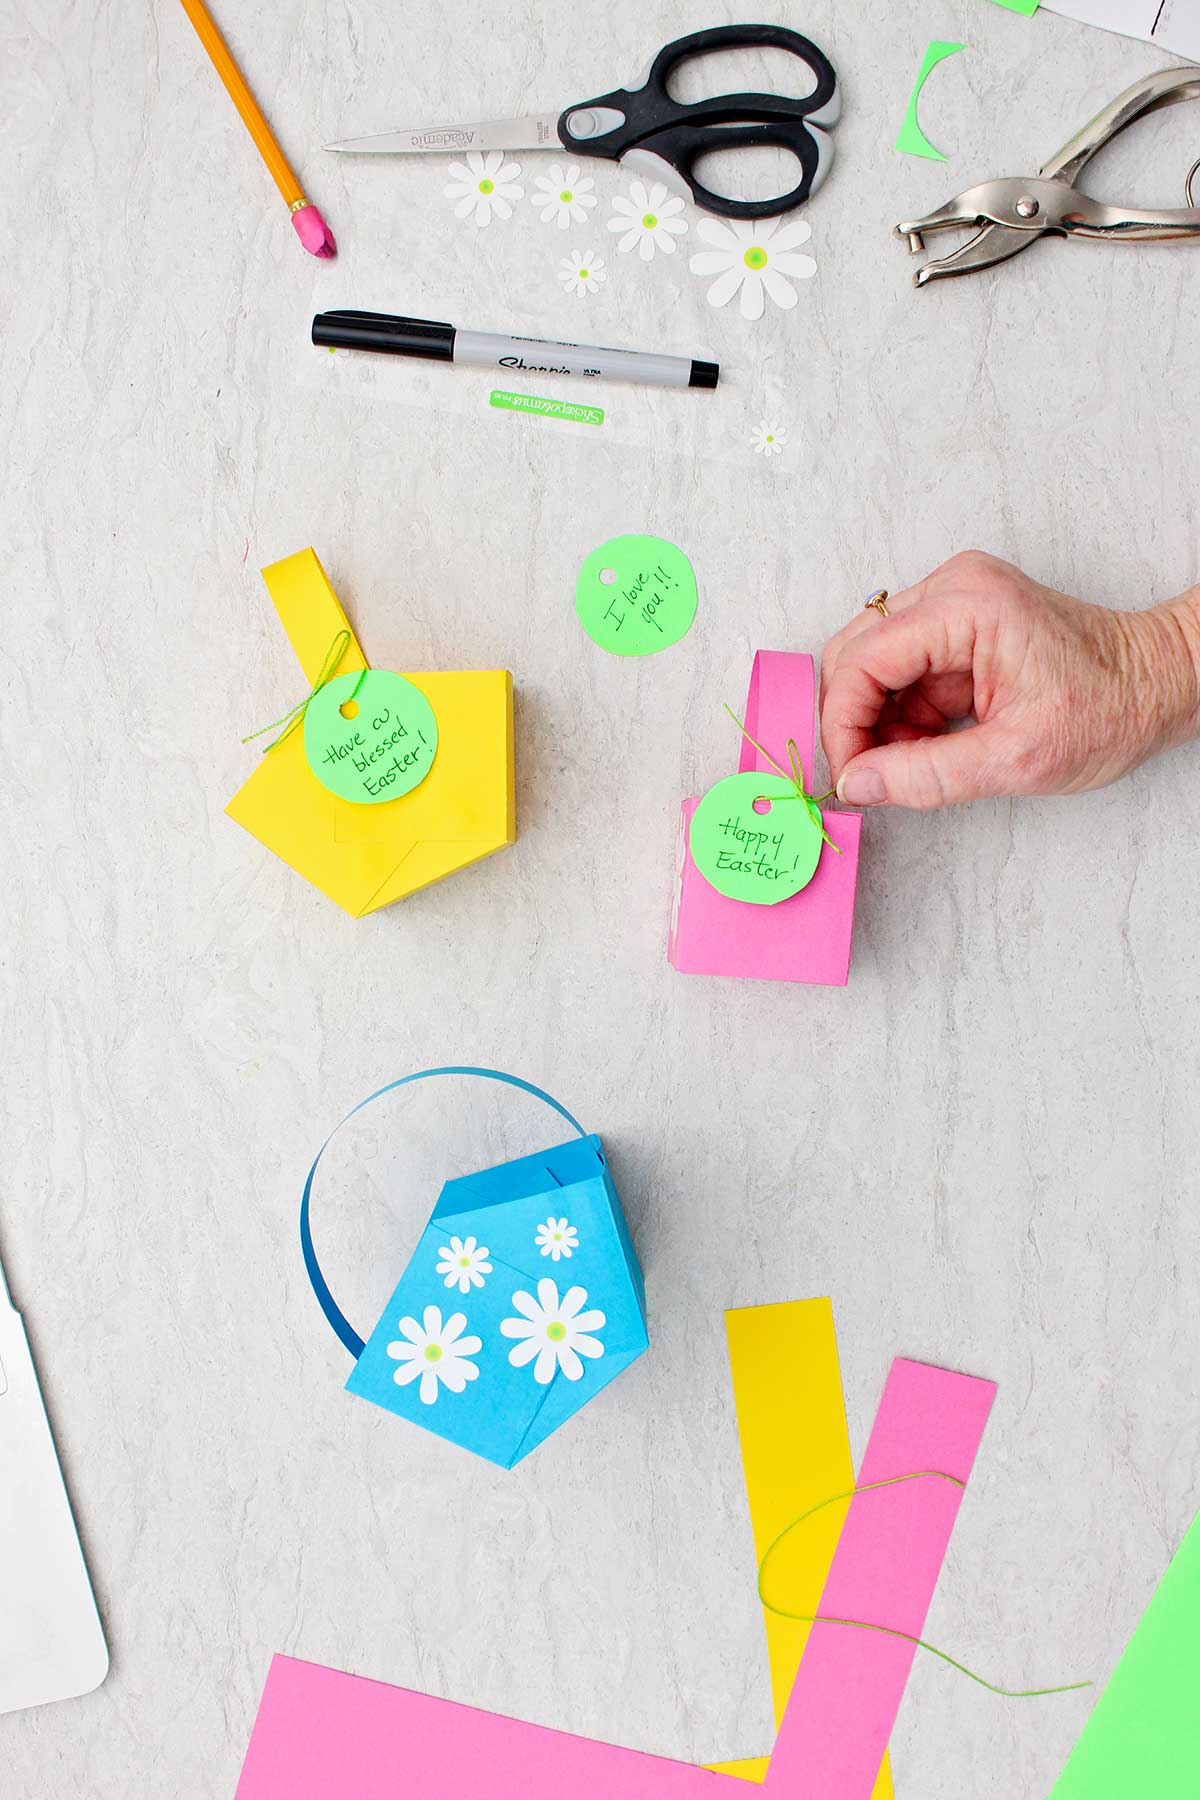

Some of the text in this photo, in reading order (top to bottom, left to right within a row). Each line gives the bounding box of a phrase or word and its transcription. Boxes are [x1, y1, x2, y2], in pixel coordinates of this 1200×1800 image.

[410, 131, 476, 148] Academic
[603, 573, 650, 632] I love
[322, 708, 391, 765] Have a
[351, 714, 409, 773] blessed
[363, 729, 433, 796] Easter!
[716, 851, 800, 883] Easter!
[718, 816, 784, 861] Happy
